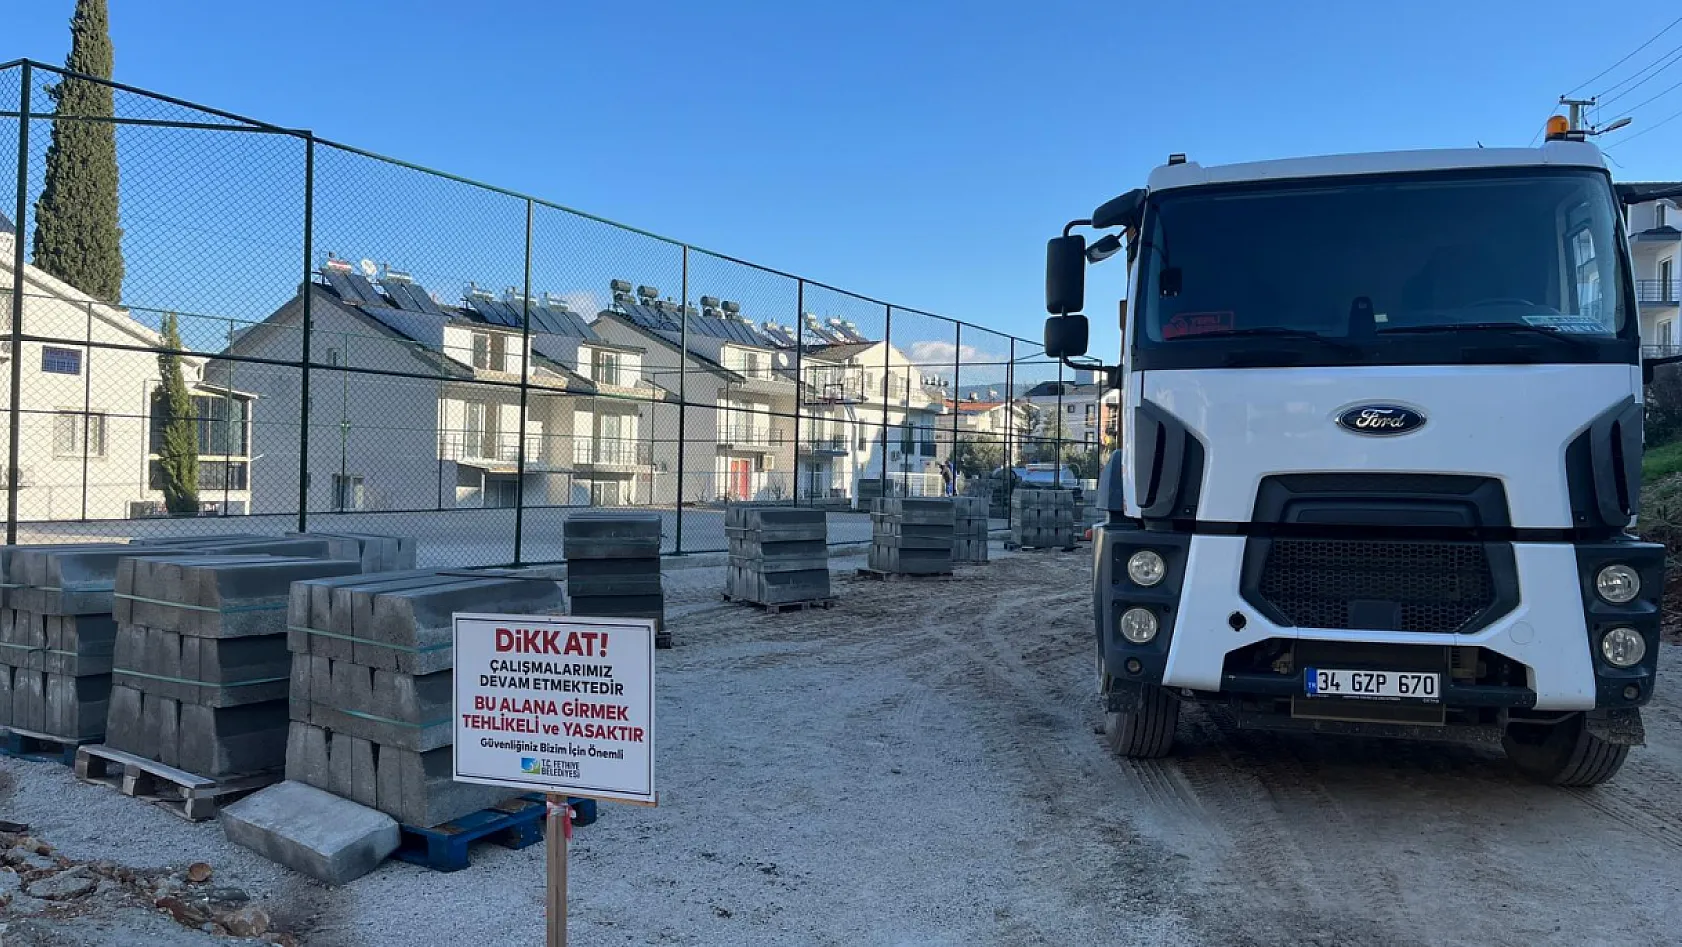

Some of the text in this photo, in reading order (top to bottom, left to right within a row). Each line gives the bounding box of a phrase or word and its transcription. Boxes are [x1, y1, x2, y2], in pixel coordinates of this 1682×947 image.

[1356, 409, 1406, 428] Ford
[490, 660, 613, 678] ÇALIŞMALARIMIZ
[480, 675, 623, 695] DEVAM ETMEKTEDİR
[1319, 672, 1434, 694] 34 GZP 670
[475, 696, 629, 721] BU ALANA GİRMEK
[463, 714, 644, 742] TEHLİKELİ ve YASAKTIR
[481, 738, 624, 760] Güvenliğiniz Bizim İçin Önemli
